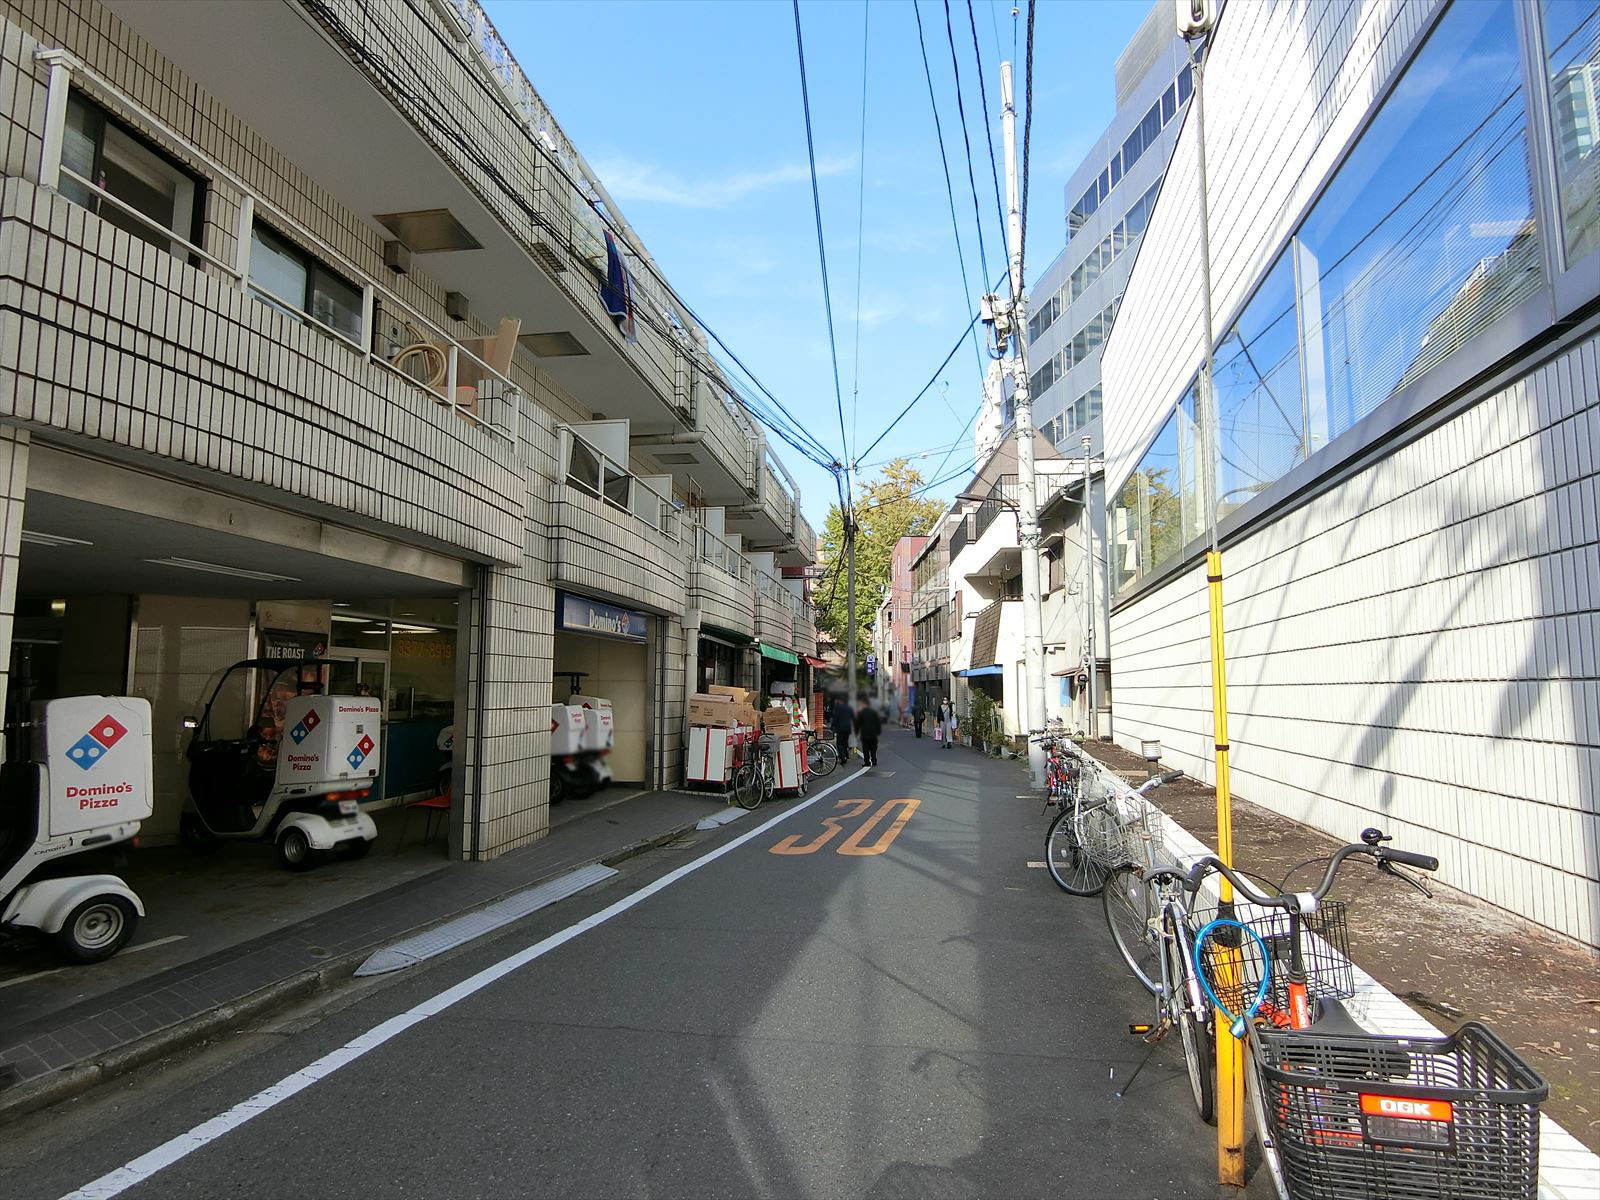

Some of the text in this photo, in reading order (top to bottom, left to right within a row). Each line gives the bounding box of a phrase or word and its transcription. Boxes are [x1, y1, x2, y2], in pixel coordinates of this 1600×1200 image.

[589, 608, 621, 632] Domino's
[266, 646, 305, 659] THE ROAST
[288, 753, 320, 762] Domino's
[292, 763, 312, 771] Pizza
[66, 782, 133, 798] Domino's
[79, 798, 118, 810] Pizza
[768, 798, 922, 856] 30
